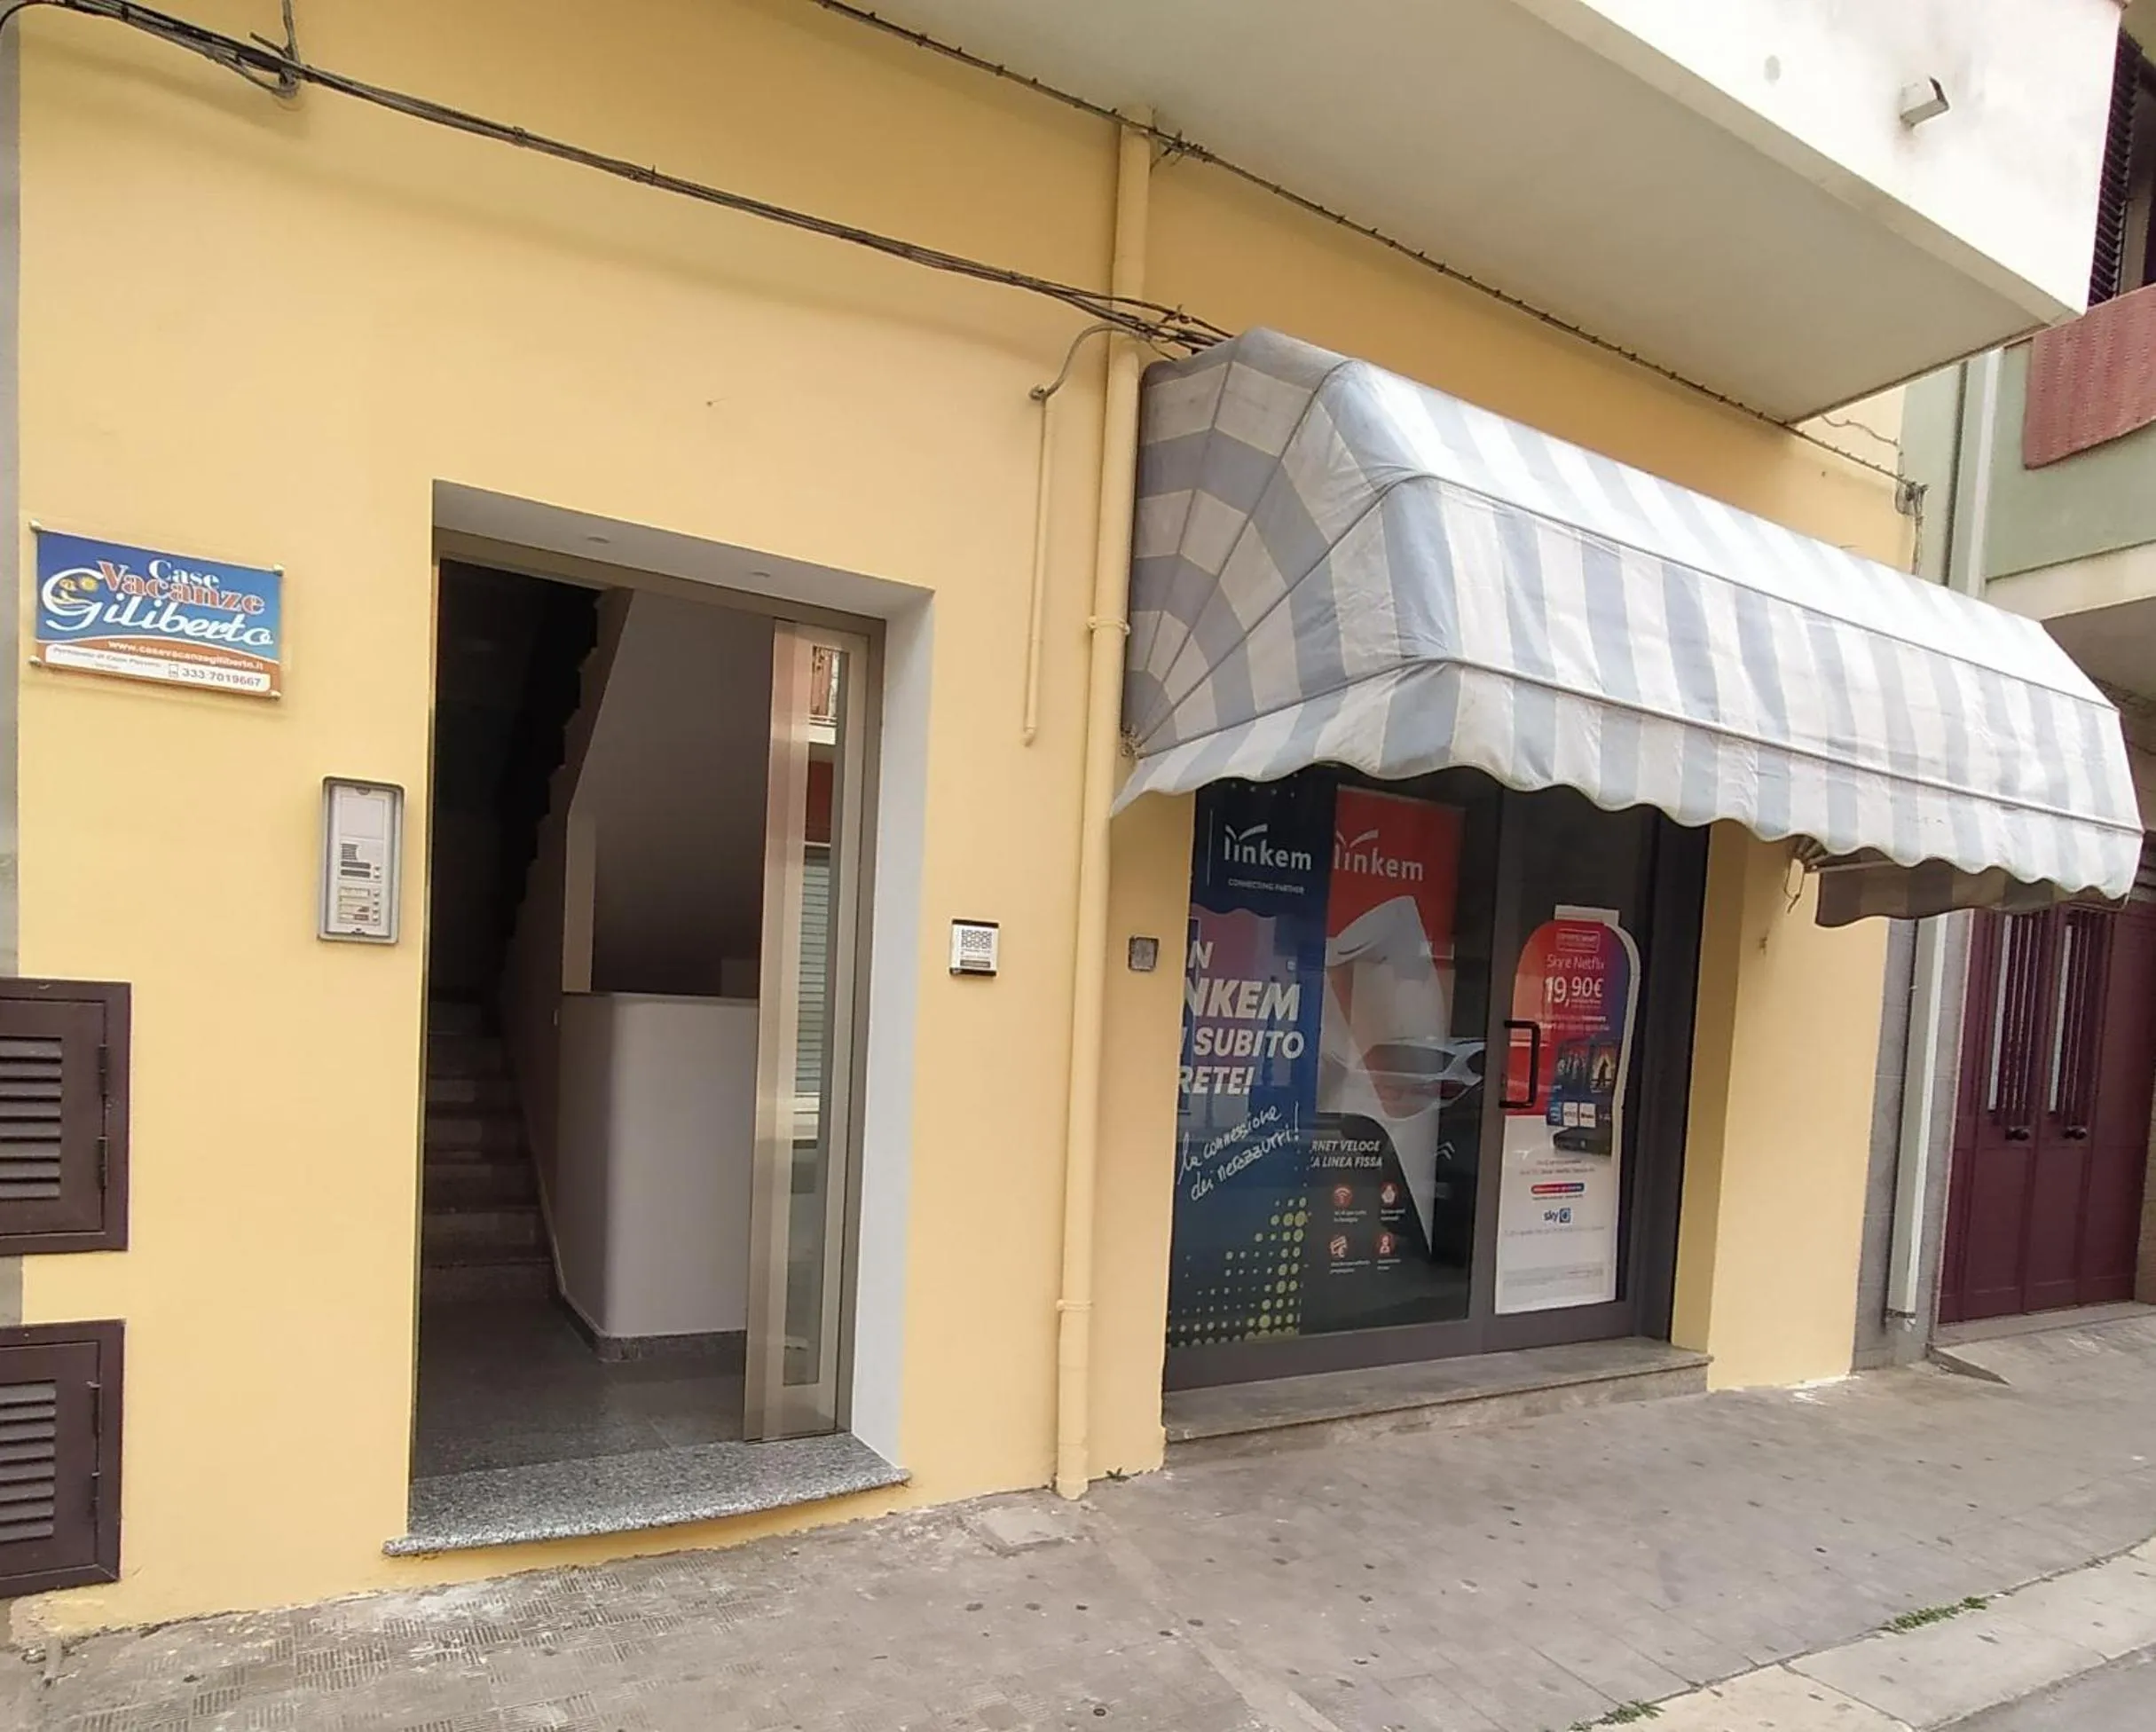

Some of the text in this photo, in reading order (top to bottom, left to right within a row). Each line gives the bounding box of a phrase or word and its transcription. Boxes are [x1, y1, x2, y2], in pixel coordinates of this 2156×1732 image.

[97, 560, 265, 614] Vacanze
[149, 560, 219, 588] Case
[42, 568, 274, 646] Giliberto
[182, 667, 206, 680] 333
[1224, 824, 1311, 870] linkem
[1334, 829, 1423, 881] linkem
[1194, 1027, 1305, 1059] SUBITO
[1203, 1105, 1282, 1159] connessione
[1341, 1139, 1381, 1153] VELOCE
[1322, 1156, 1352, 1169] LINEA
[1355, 1156, 1383, 1169] FISSA
